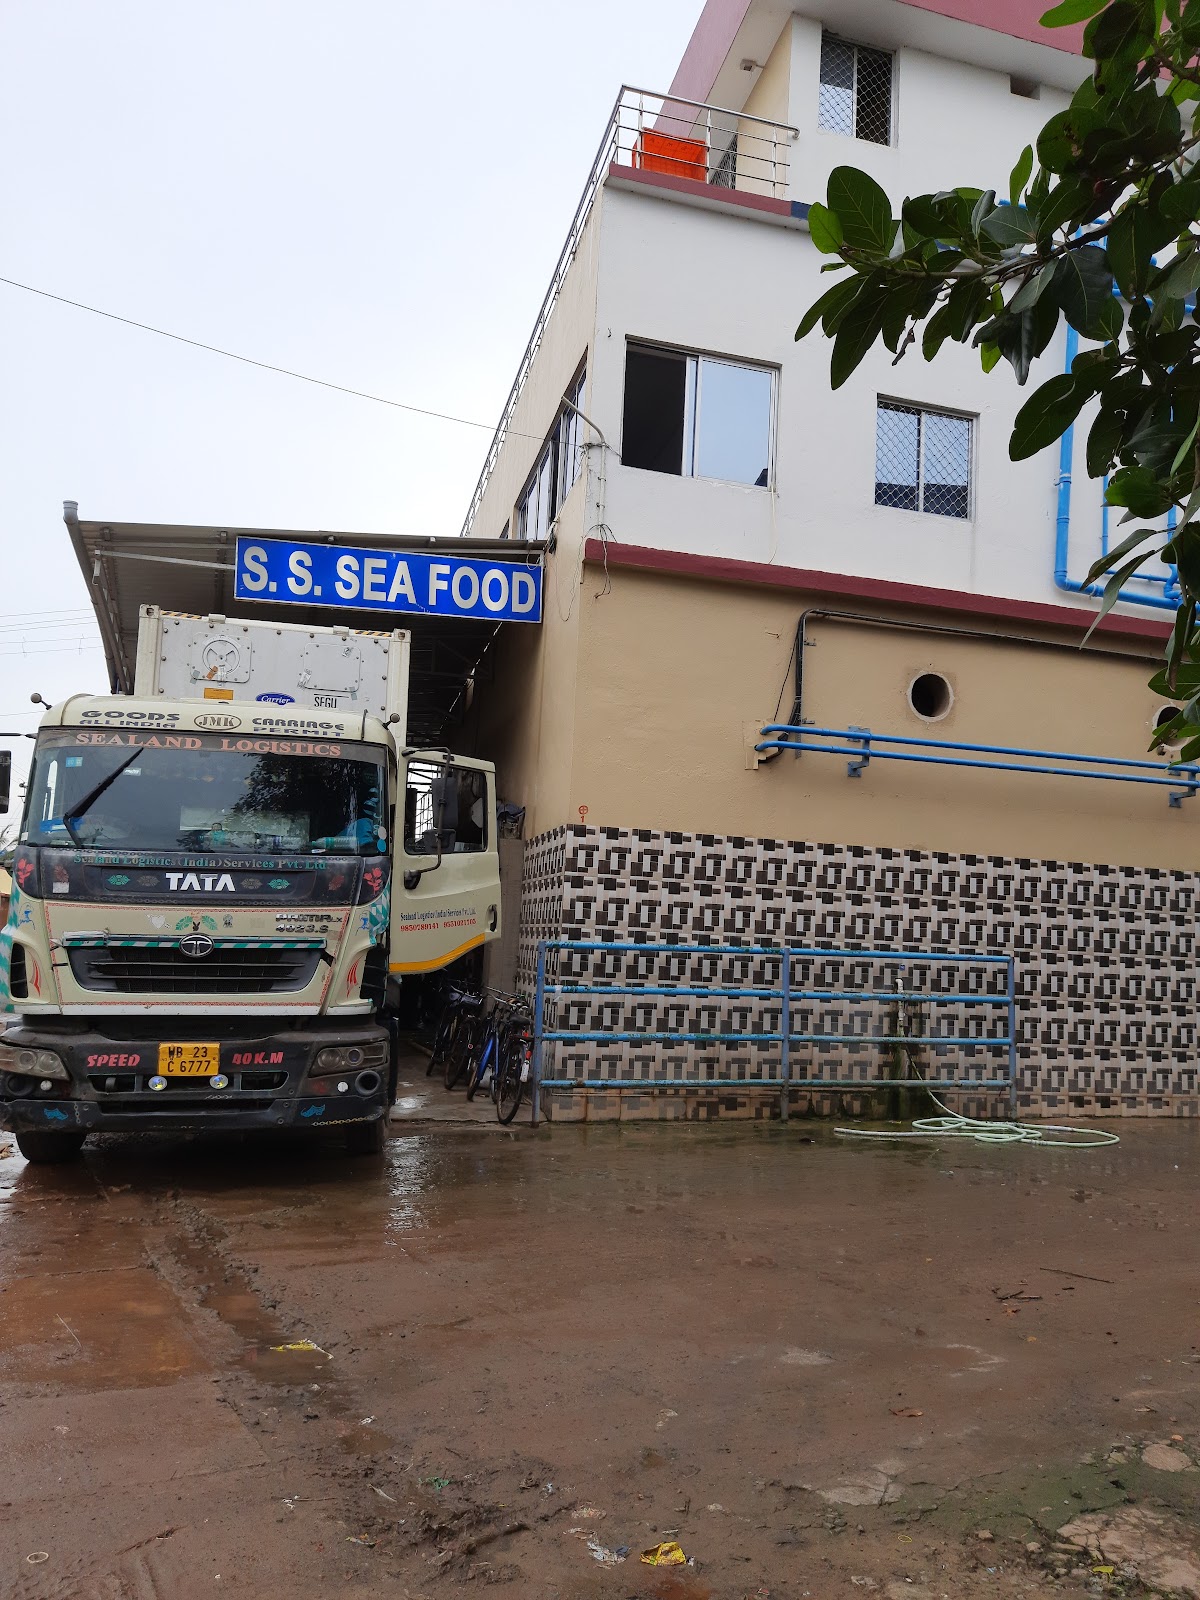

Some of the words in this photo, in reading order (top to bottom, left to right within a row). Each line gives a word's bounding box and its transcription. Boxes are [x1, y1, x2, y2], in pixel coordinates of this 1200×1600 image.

[241, 546, 277, 592] S.
[286, 551, 322, 596] S.
[334, 555, 417, 604] SEA
[428, 563, 536, 613] FOOD
[260, 695, 291, 704] Carrier
[81, 710, 180, 721] GOODS
[252, 717, 345, 731] CARRIAGE
[198, 716, 235, 727] JMK
[120, 720, 176, 729] INDIA
[253, 727, 345, 737] PERMIT
[76, 733, 202, 749] SEALAND
[220, 739, 341, 757] LOGISTICS
[73, 854, 120, 864] Sealand
[223, 858, 274, 868] Services
[165, 872, 236, 892] TATA
[168, 1046, 183, 1058] WB
[193, 1046, 208, 1058] 23
[86, 1054, 140, 1067] SPEED
[167, 1061, 175, 1073] C
[180, 1060, 211, 1073] 6777
